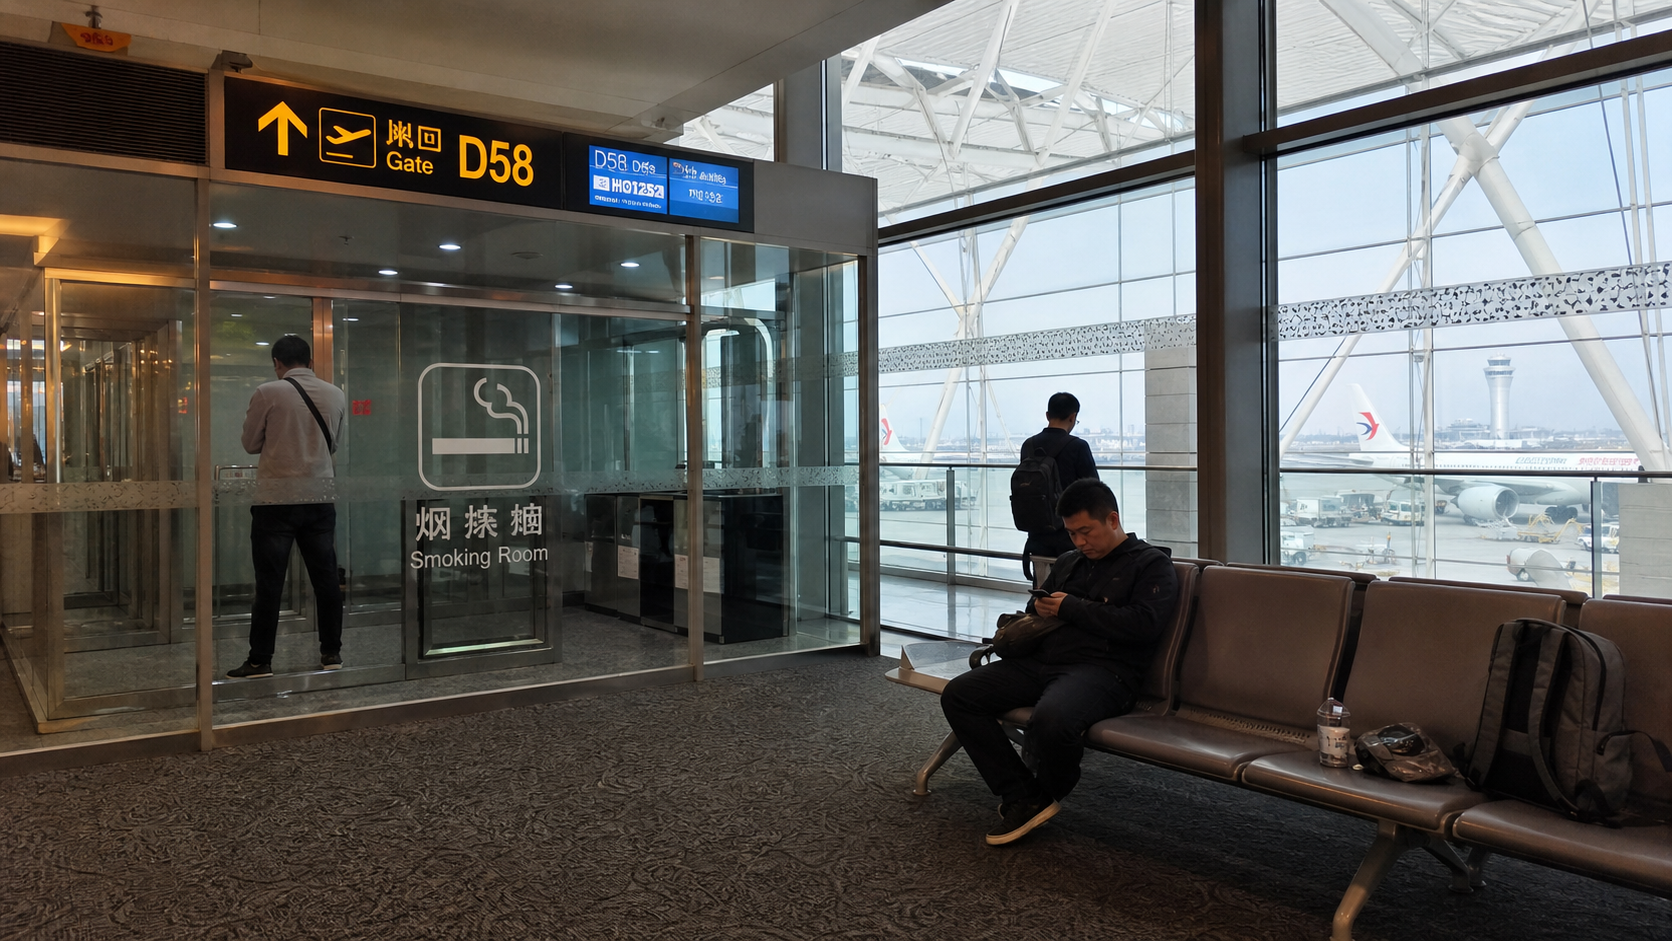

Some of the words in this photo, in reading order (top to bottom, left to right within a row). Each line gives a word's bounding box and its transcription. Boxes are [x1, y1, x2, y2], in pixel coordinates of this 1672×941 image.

[386, 151, 434, 175] Gate
[459, 134, 534, 187] D58
[410, 548, 491, 570] Smoking
[498, 546, 548, 564] Room
